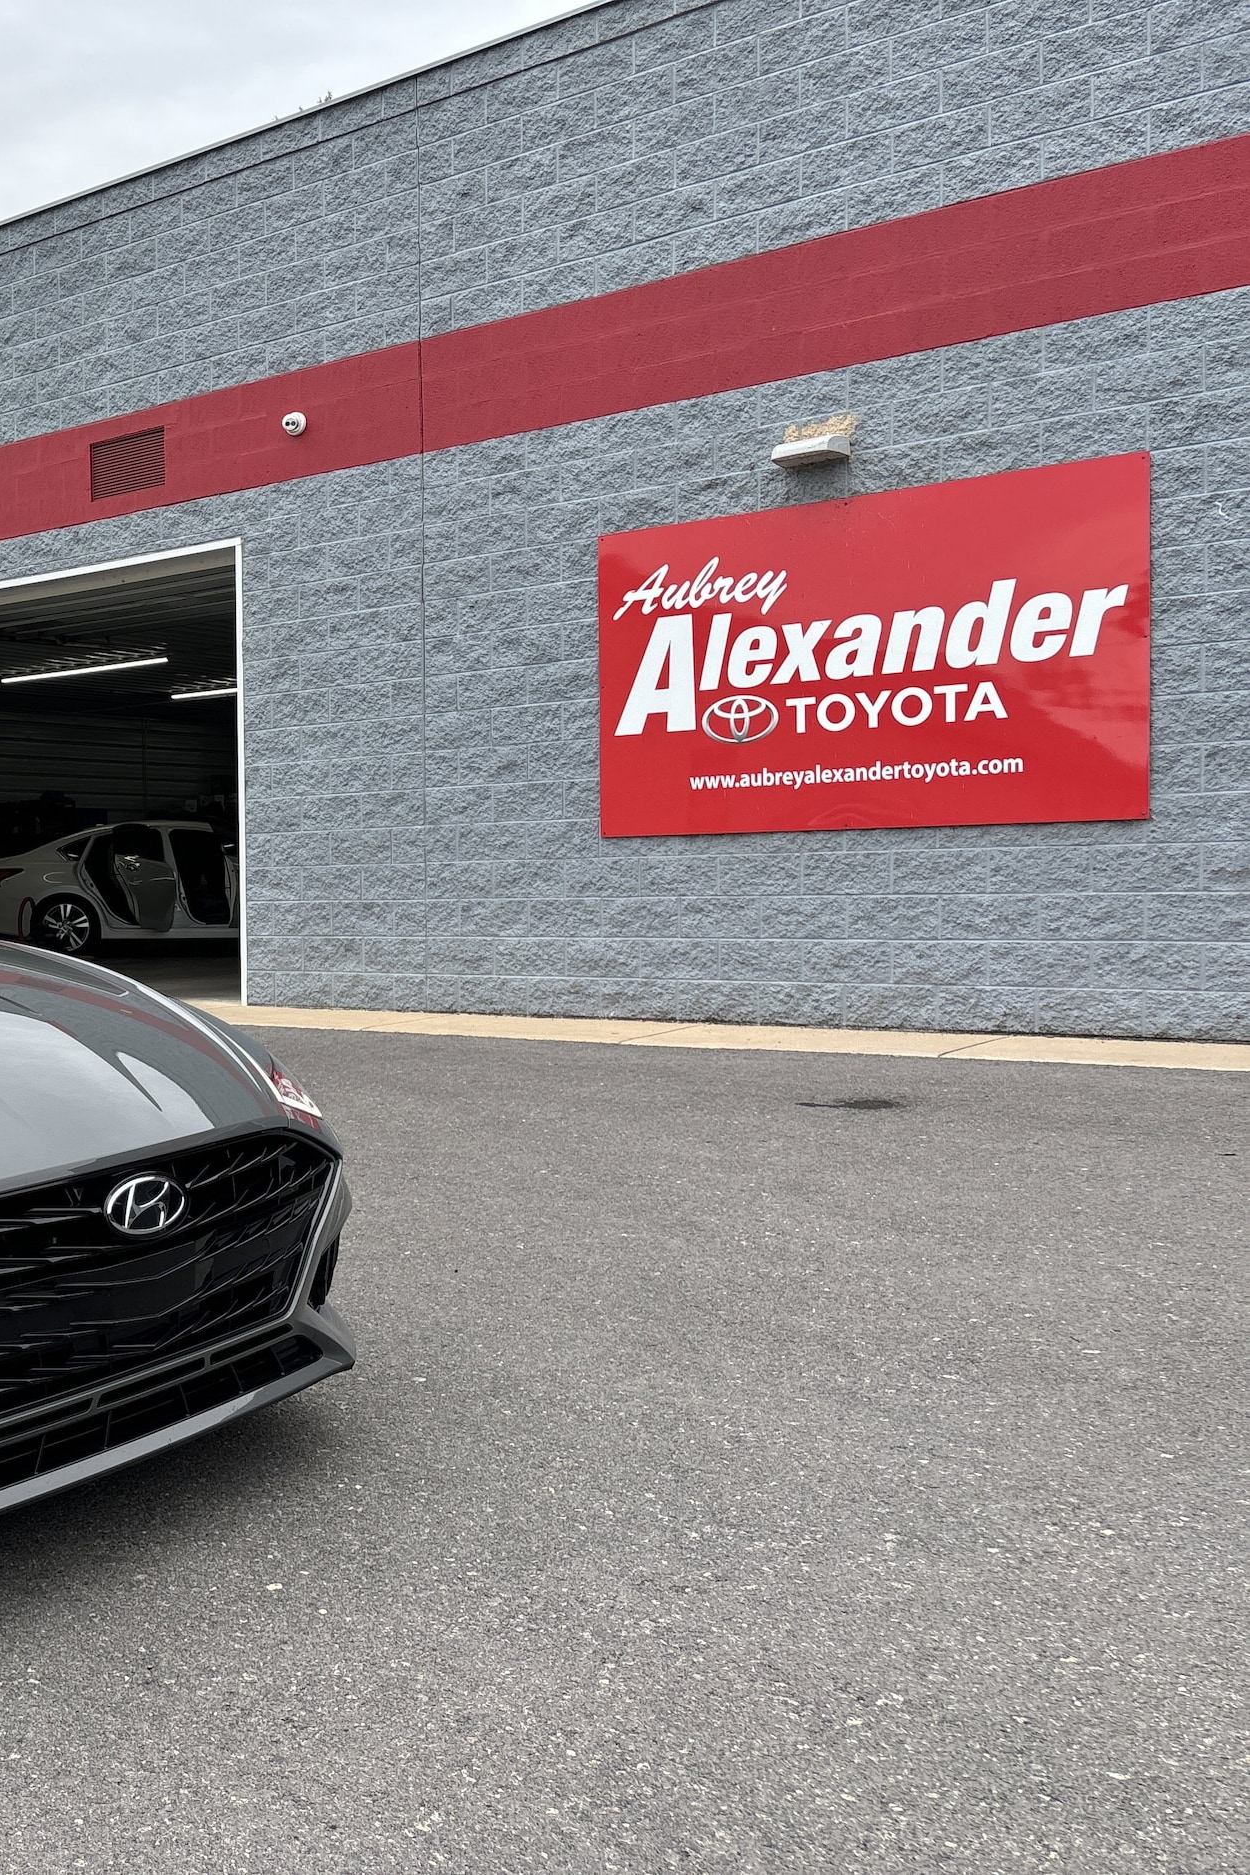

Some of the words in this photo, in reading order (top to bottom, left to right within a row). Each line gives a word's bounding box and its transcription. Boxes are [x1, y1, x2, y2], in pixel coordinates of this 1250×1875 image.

[613, 556, 788, 621] Aubrey
[614, 578, 1129, 737] Alexander
[786, 681, 1009, 734] TOYOTA
[689, 755, 1024, 791] www.aubreyalexandertoyota.com
